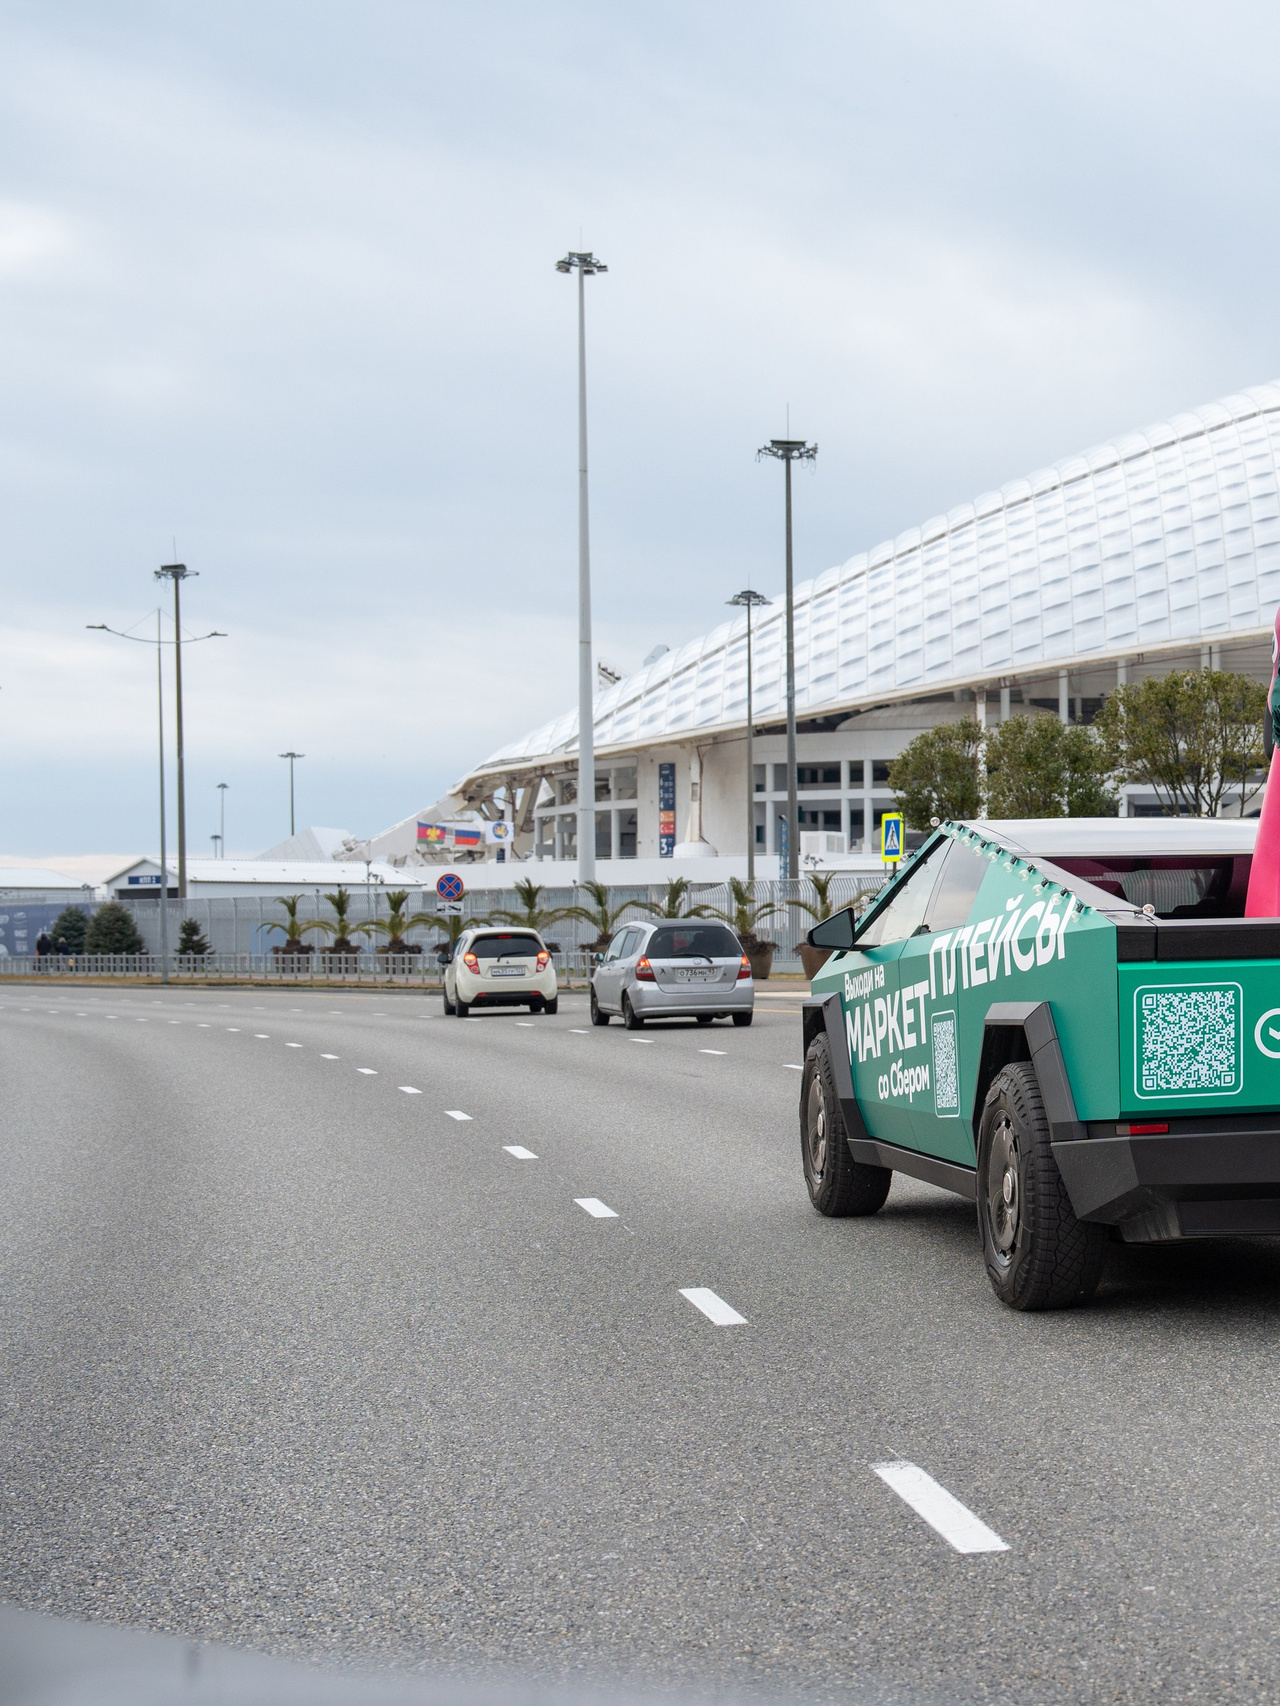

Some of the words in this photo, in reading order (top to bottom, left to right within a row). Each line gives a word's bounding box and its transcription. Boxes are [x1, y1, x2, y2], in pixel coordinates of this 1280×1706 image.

[929, 894, 1077, 1000] ПЛЕЙСЫ
[844, 970, 874, 1002] Выходи
[874, 964, 885, 990] на
[845, 979, 930, 1066] МАРКЕТ
[878, 1074, 889, 1100] со
[890, 1058, 930, 1103] Сбером
